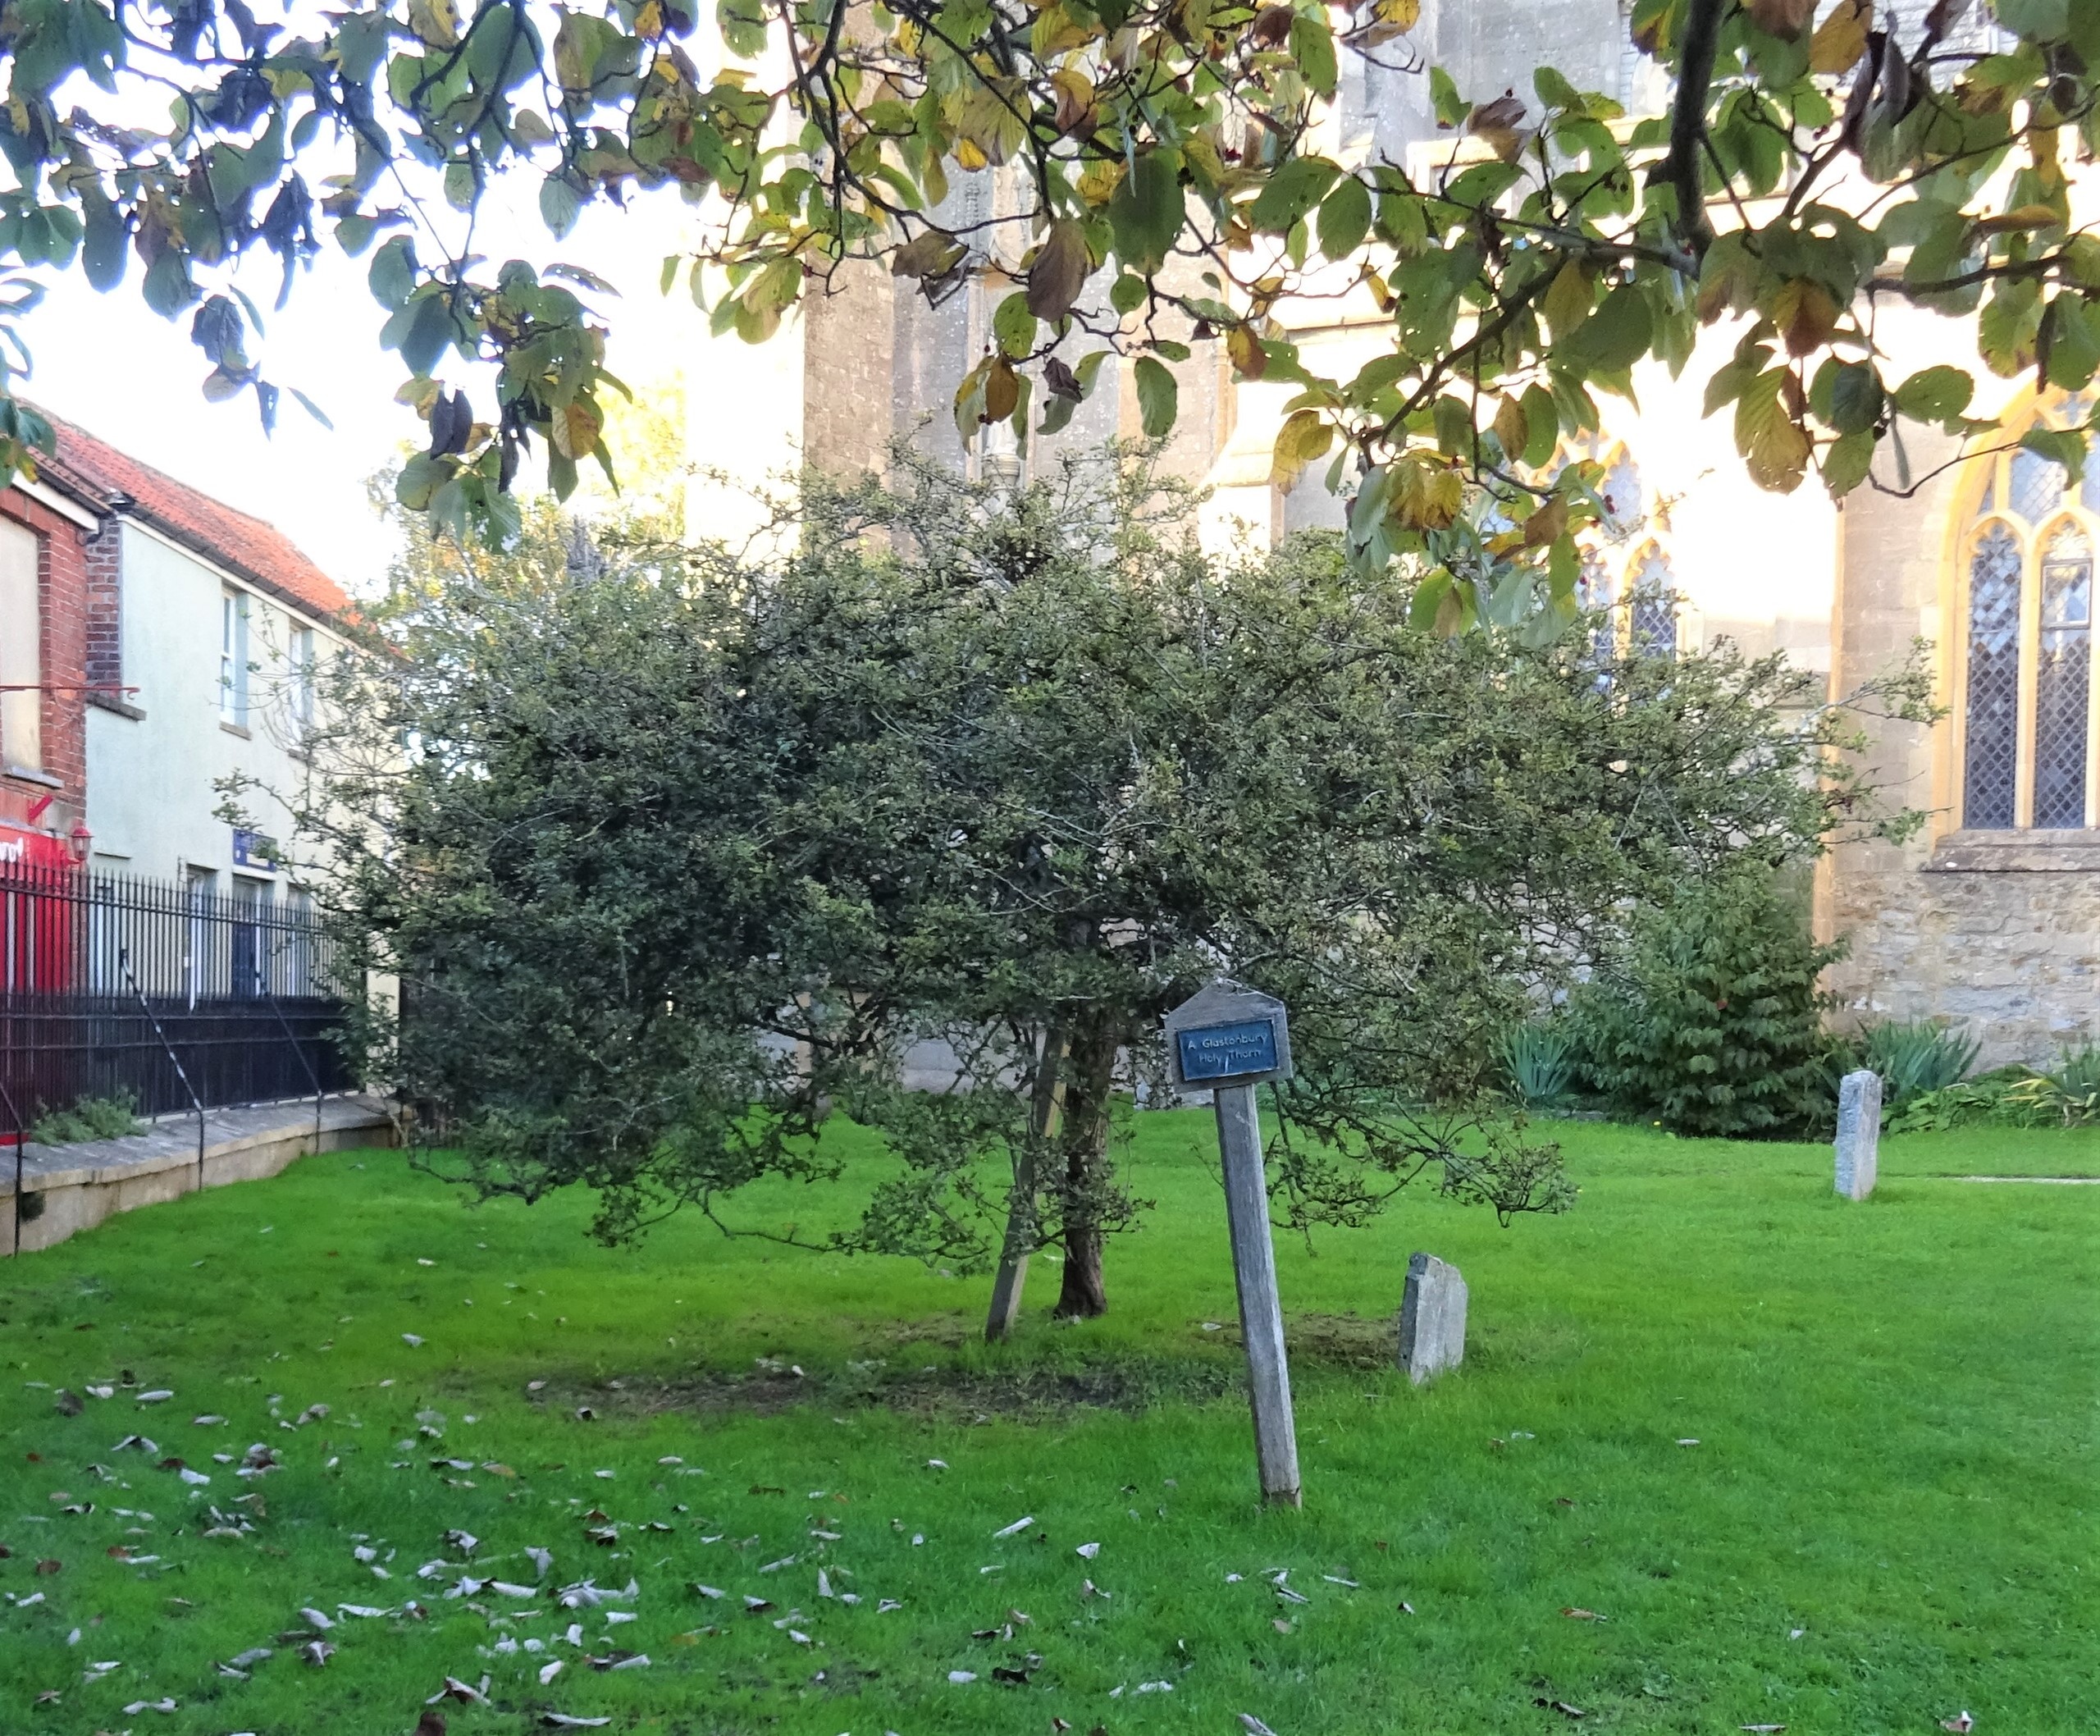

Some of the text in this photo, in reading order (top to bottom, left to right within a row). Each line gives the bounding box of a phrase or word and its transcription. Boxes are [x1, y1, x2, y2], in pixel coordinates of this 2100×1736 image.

[1188, 1034, 1267, 1050] A Glastonbury
[1198, 1048, 1262, 1067] Holy Thorn
